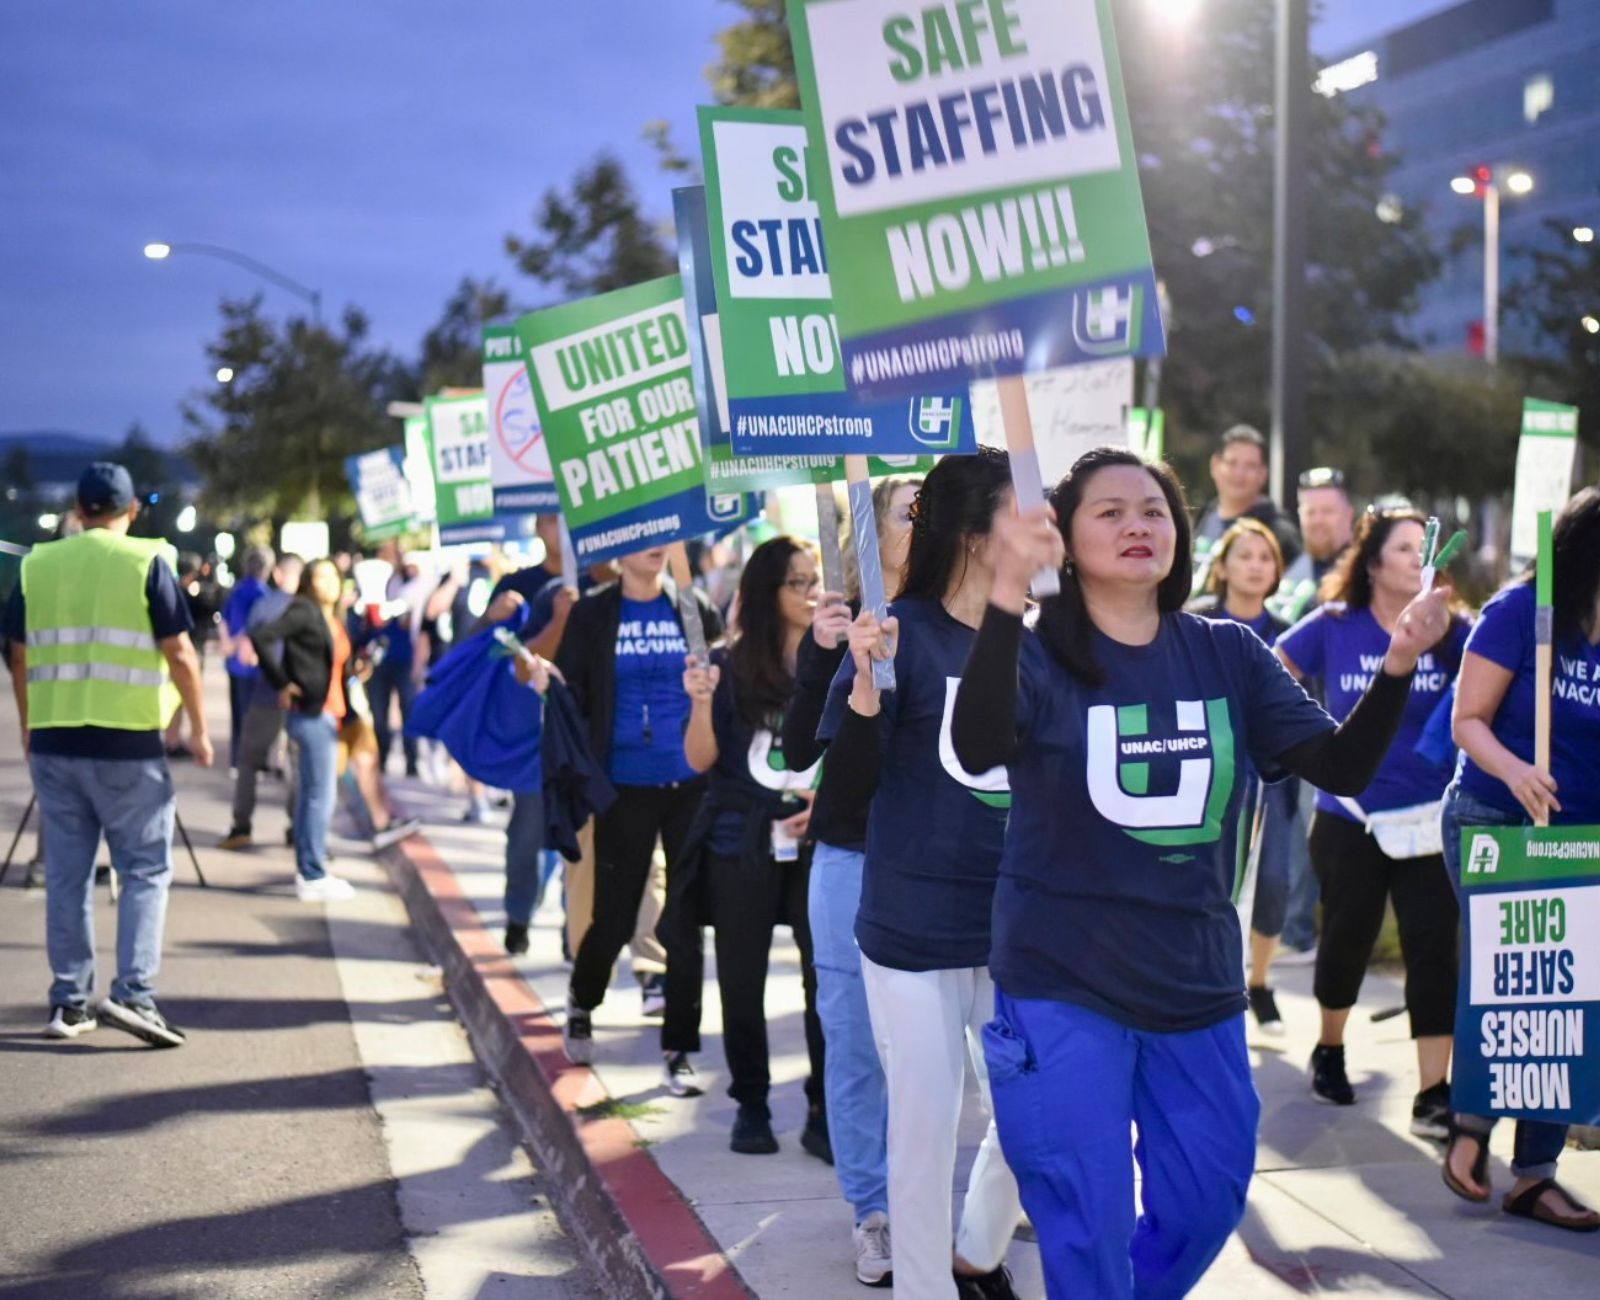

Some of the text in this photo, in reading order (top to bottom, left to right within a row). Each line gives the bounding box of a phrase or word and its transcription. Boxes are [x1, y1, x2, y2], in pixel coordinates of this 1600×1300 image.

[882, 0, 1028, 84] SAFE
[834, 62, 1106, 186] STAFFING
[886, 185, 1085, 303] NOW!!!
[555, 312, 687, 393] UNITED
[769, 313, 842, 377] NO
[852, 329, 1024, 385] #UNACUHCPstrong
[579, 376, 695, 444] FOR OUR
[736, 415, 873, 438] #UNACUHCPstrong
[577, 514, 681, 555] #UNACUHCPstrong
[1560, 655, 1588, 680] WE
[1121, 737, 1208, 755] UNAC/UHCP
[1499, 897, 1566, 946] CARE
[1493, 949, 1575, 997] SAFER
[1481, 1009, 1584, 1058] NURSES
[1489, 1062, 1572, 1110] MORE
